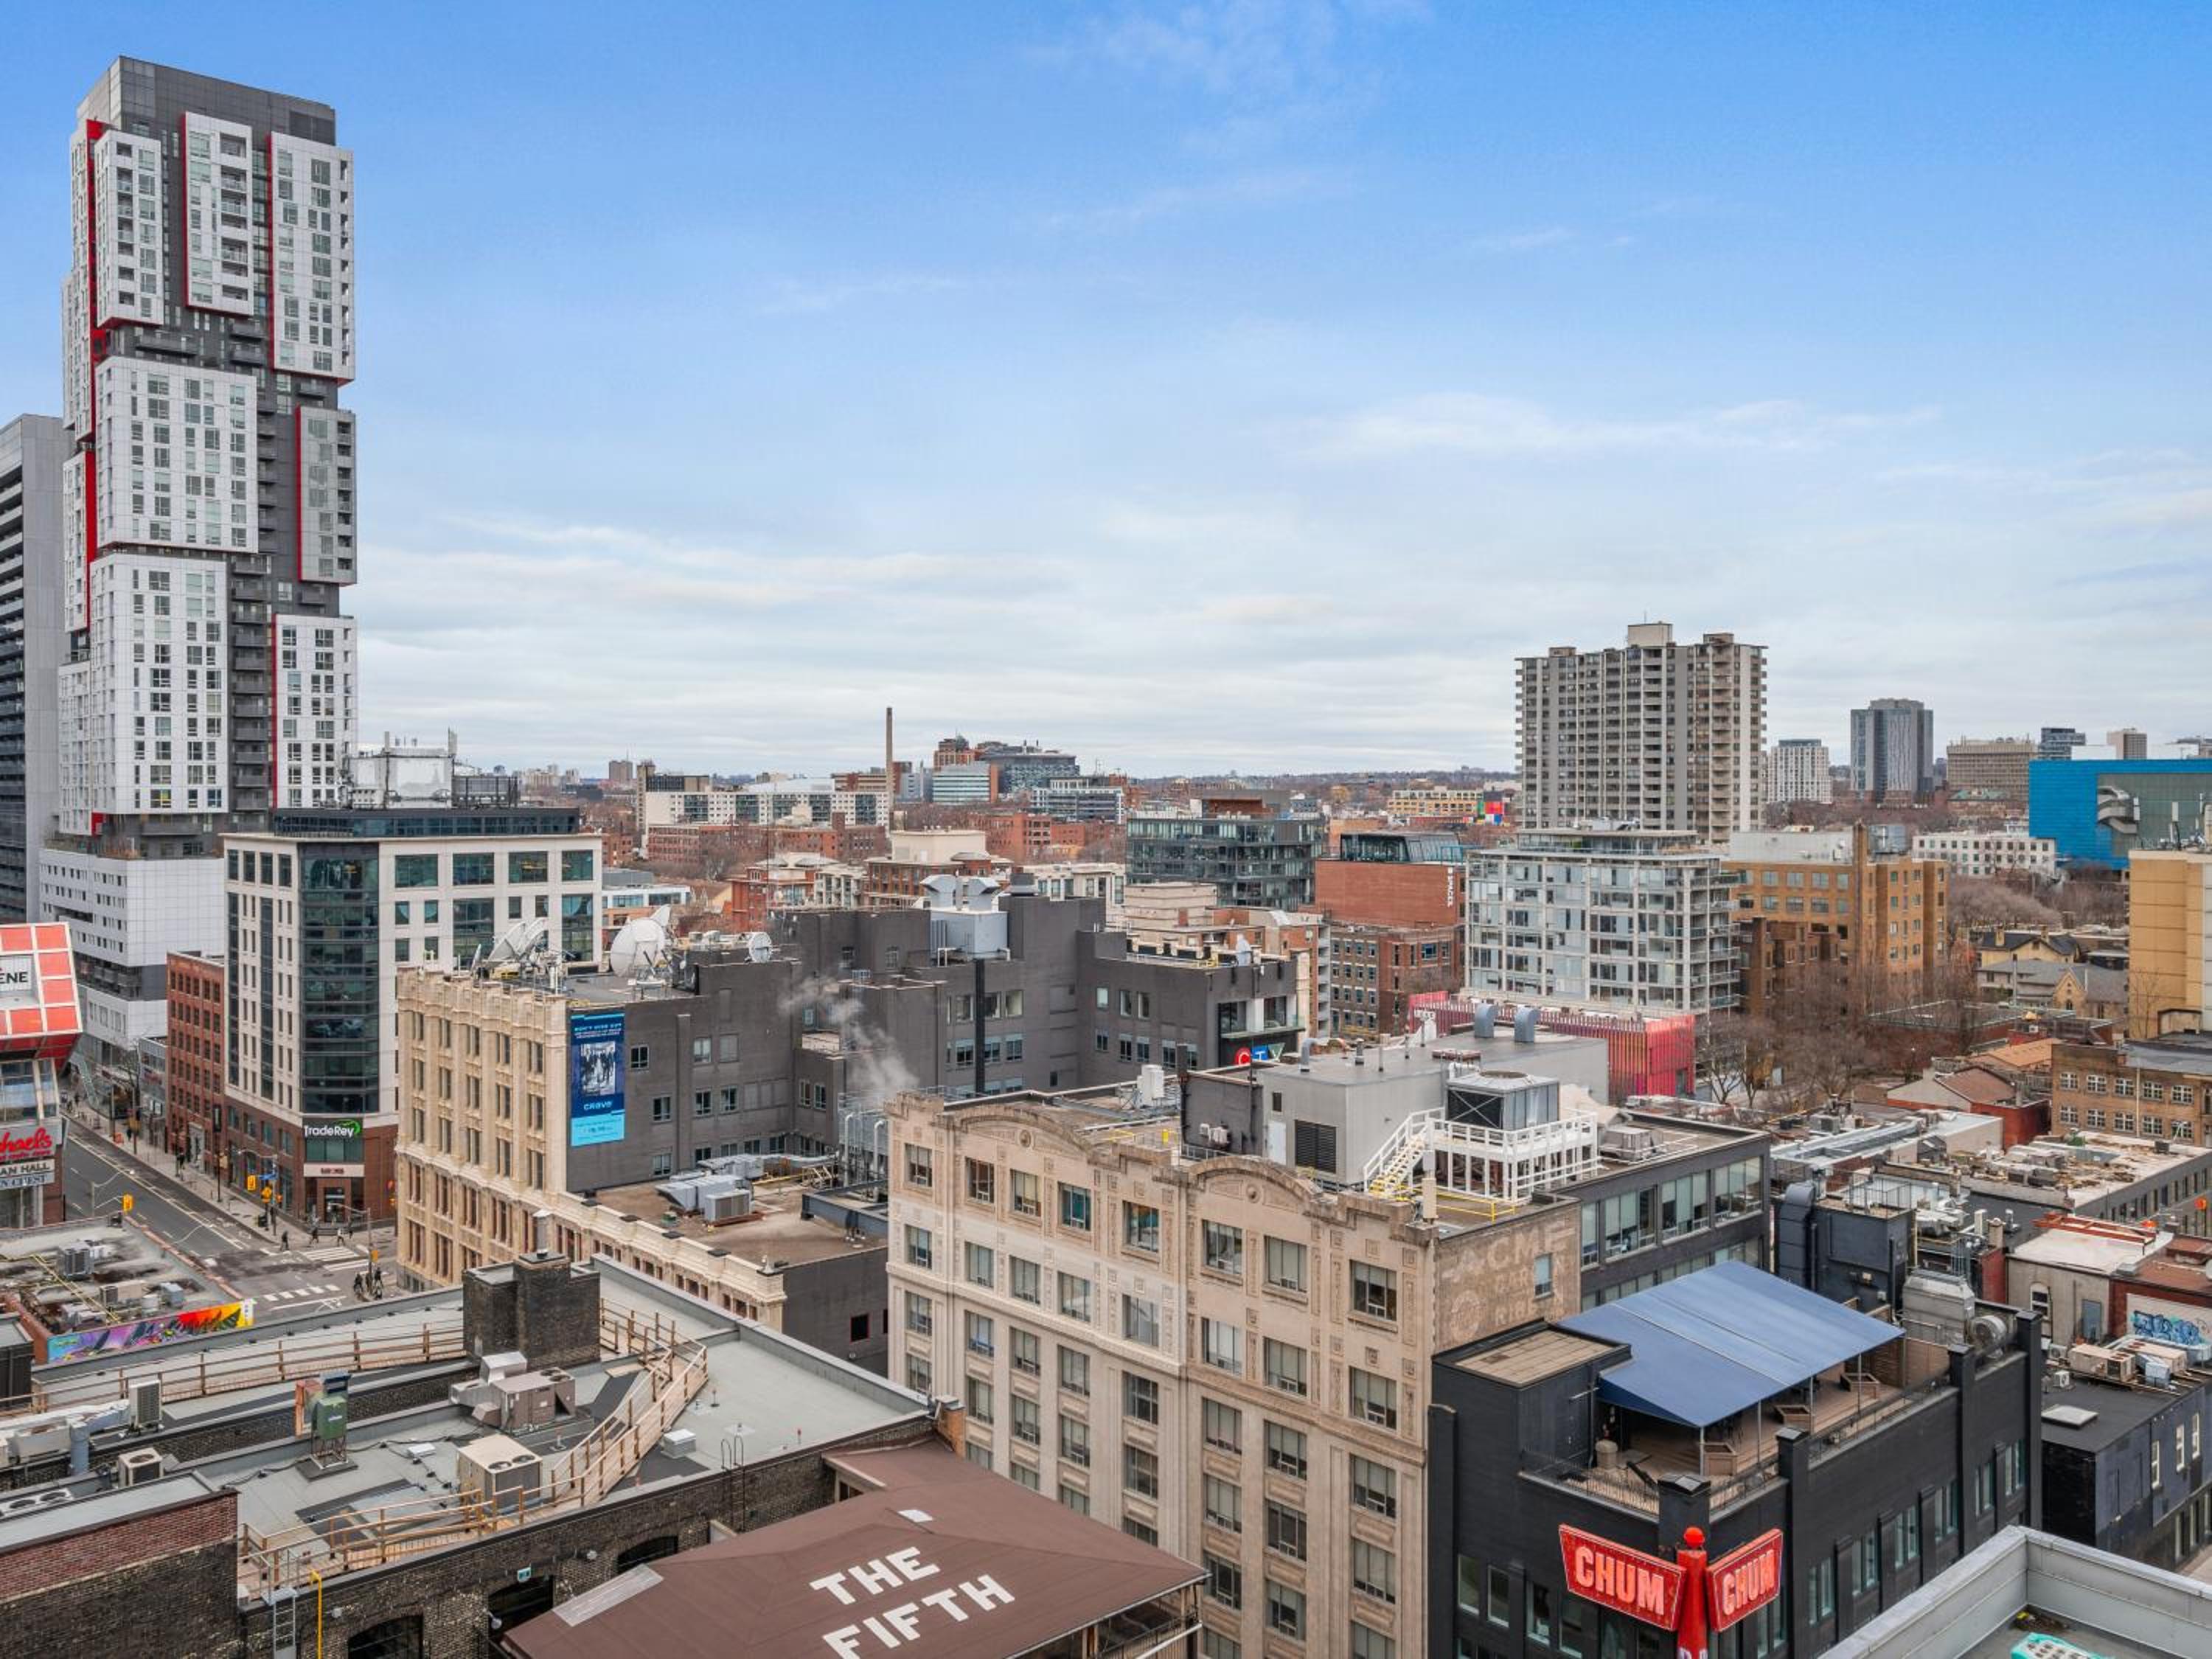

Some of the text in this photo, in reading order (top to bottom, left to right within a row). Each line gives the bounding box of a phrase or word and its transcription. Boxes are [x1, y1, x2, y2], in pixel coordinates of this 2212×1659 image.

[0, 1127, 52, 1152] haels
[21, 1163, 49, 1173] HALL
[809, 1546, 941, 1605] THE
[1575, 1546, 1664, 1616] CHUM
[1722, 1549, 1775, 1616] CHUM
[822, 1573, 1015, 1659] FIFTH
